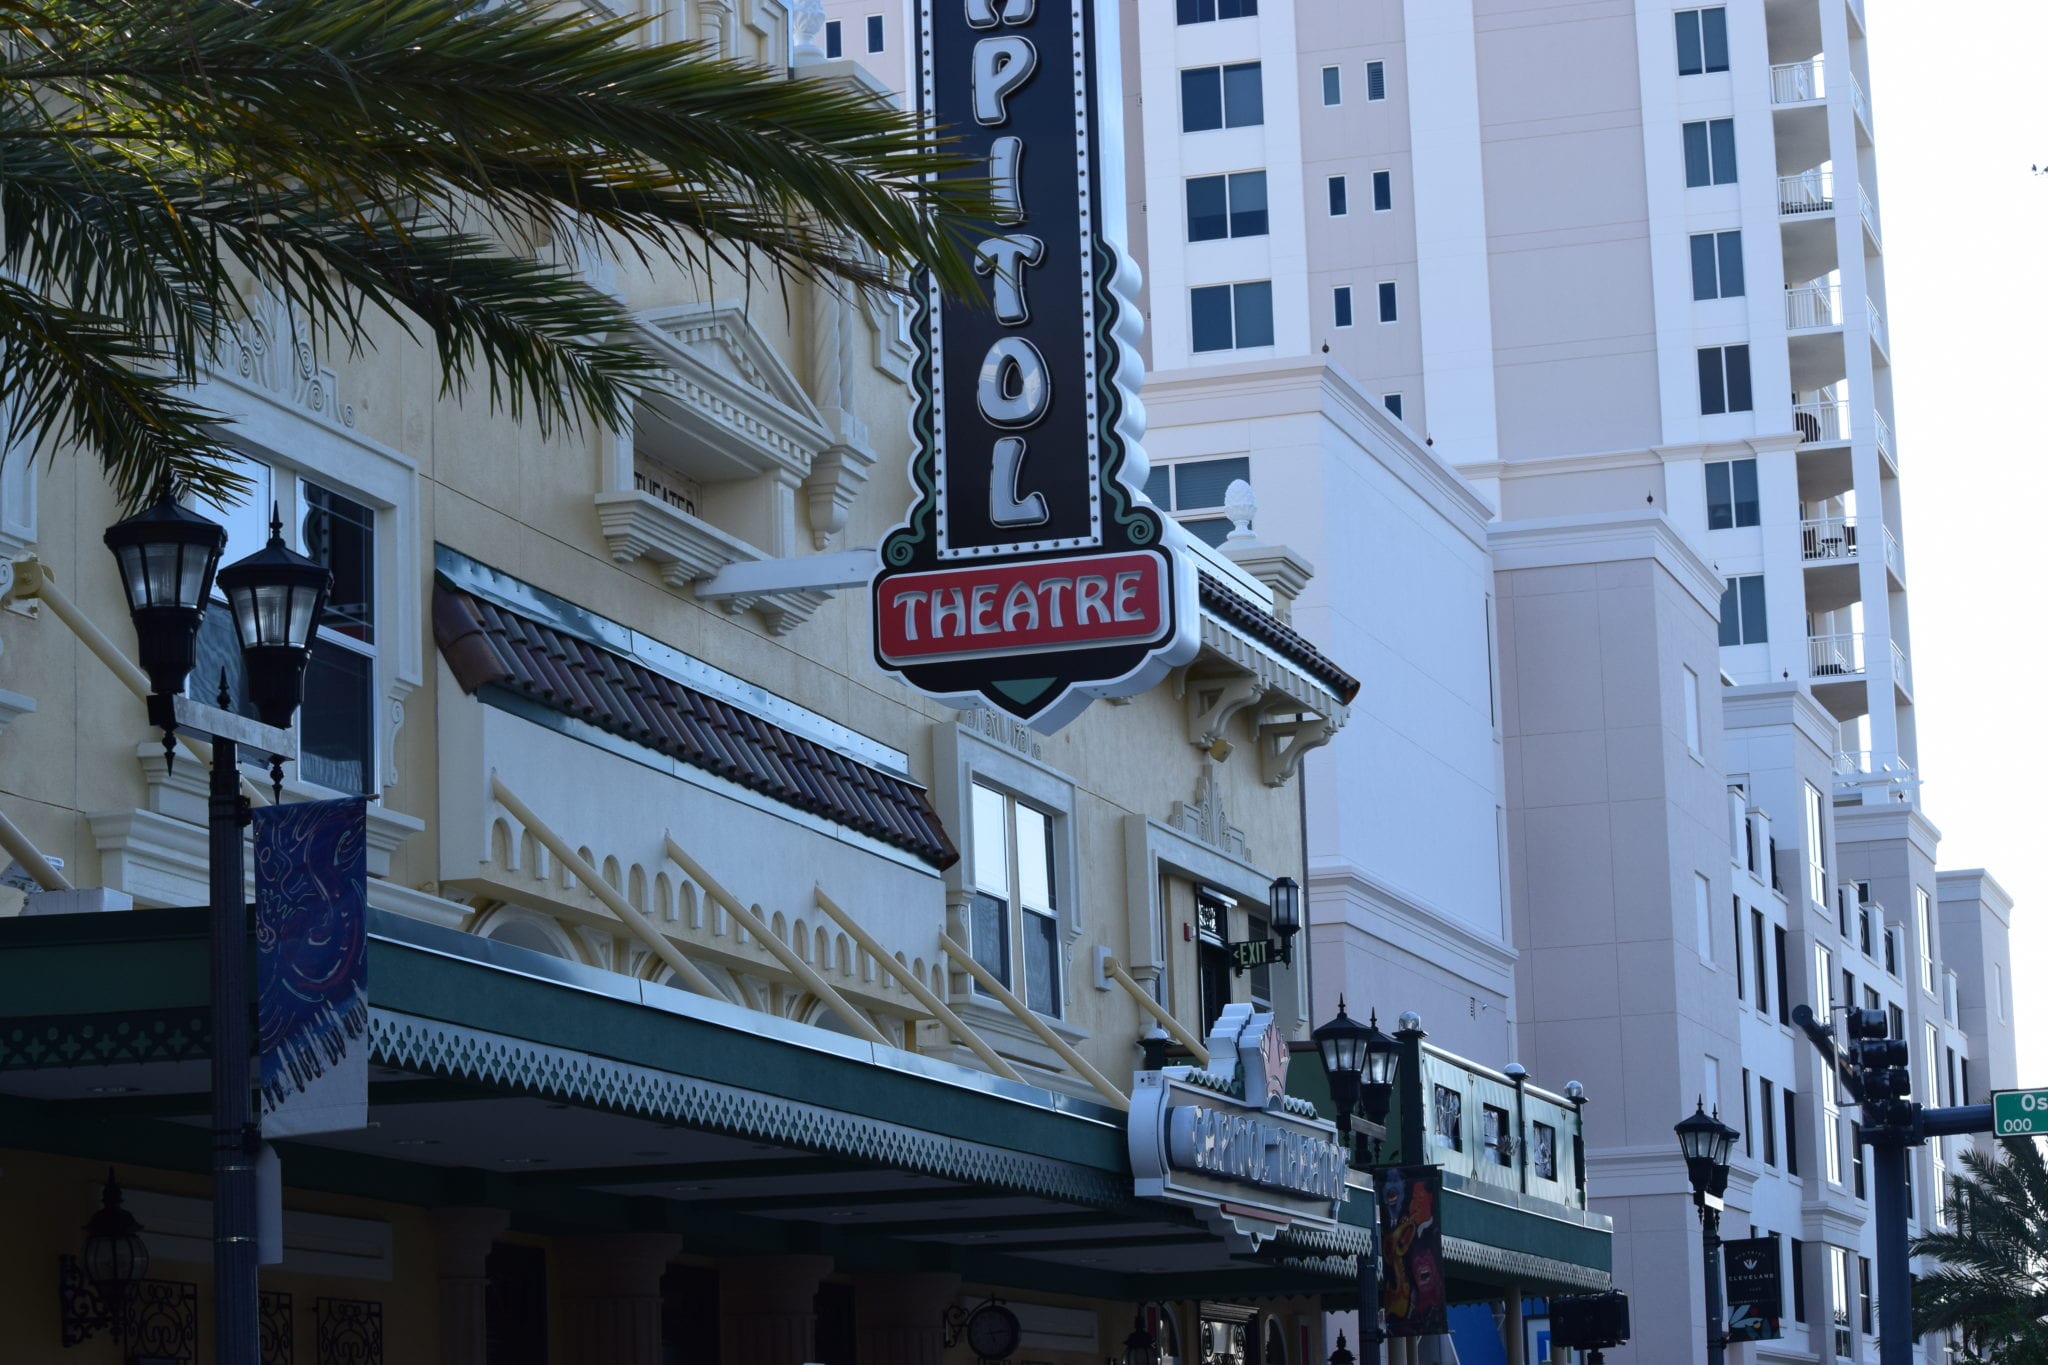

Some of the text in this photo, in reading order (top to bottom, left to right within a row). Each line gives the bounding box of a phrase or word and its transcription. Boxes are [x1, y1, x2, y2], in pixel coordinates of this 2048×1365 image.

[893, 570, 1149, 641] THEATRE
[1240, 941, 1267, 964] EXIT
[2003, 1118, 2032, 1133] 000
